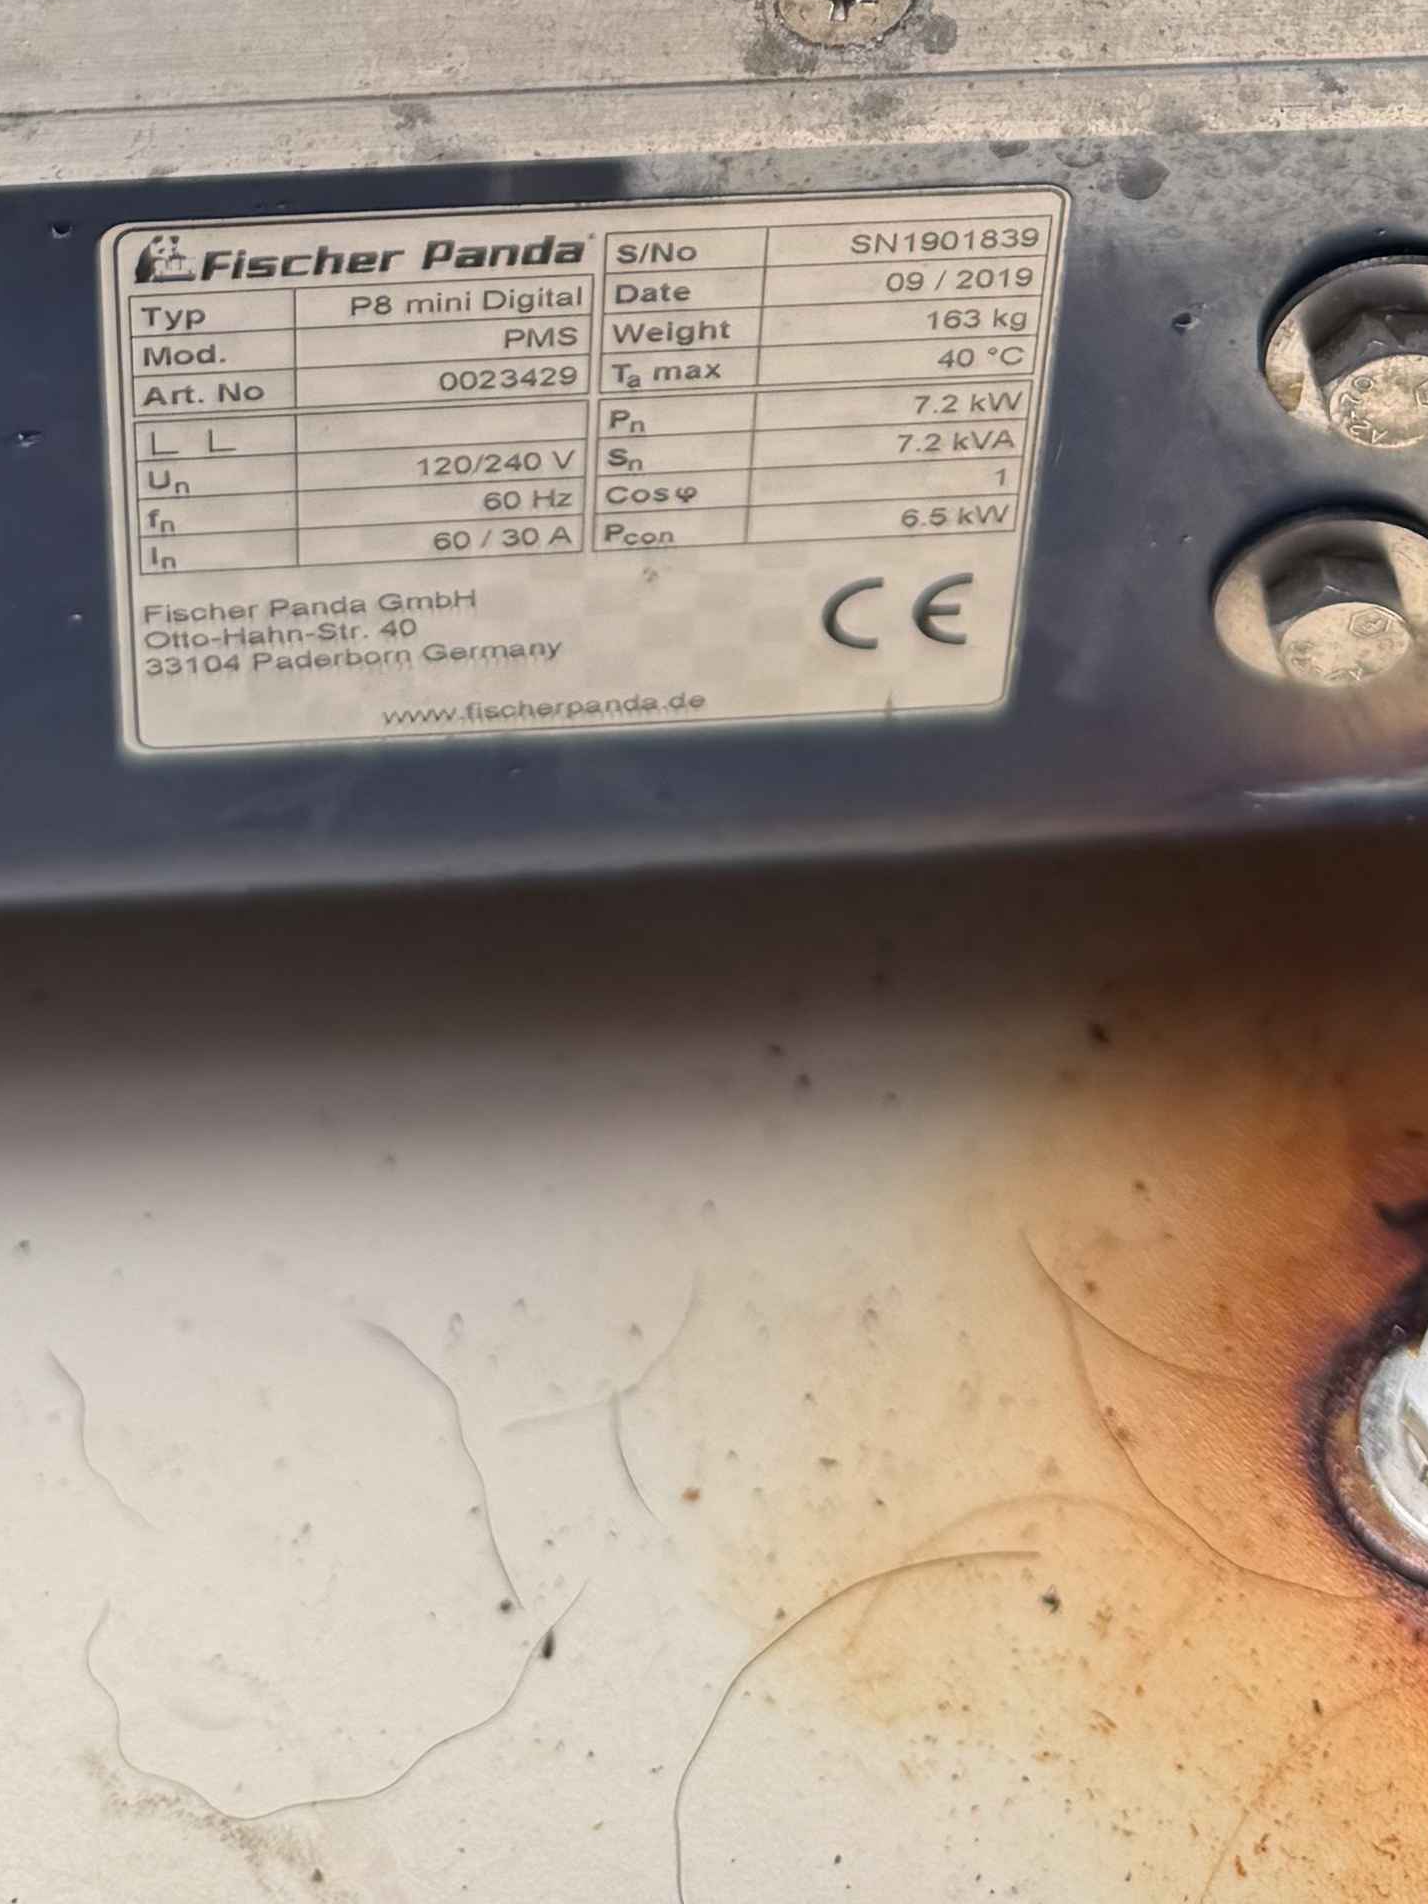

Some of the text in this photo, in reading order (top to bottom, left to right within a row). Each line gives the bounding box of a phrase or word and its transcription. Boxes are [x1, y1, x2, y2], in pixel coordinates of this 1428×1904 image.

[201, 234, 587, 283] Fischer Panda
[615, 228, 1040, 265] S/No SN1901839
[615, 267, 1034, 305] Date 09 2019
[142, 286, 584, 332] Typ P8 mini Digital
[613, 307, 1028, 346] Weight 163 kg
[143, 327, 579, 367] Mod. PMS
[653, 345, 1025, 383] max 40 °C
[143, 366, 578, 407] Art. No 0023429
[915, 391, 1023, 415] 7.2 kW
[897, 429, 1015, 453] 7.2 kVA
[417, 450, 576, 477] 120/240 V
[483, 490, 574, 511] 60 Hz
[901, 509, 947, 529] 6.5
[957, 505, 1010, 526] kW
[433, 526, 573, 552] 60 30 A
[144, 589, 477, 625] Fischer Panda GmbH
[145, 617, 418, 650] Otto-Hahn-Str. 40
[146, 638, 563, 677] 33104 Paderborn Germany
[381, 691, 706, 727] www.fischerpanda.de
